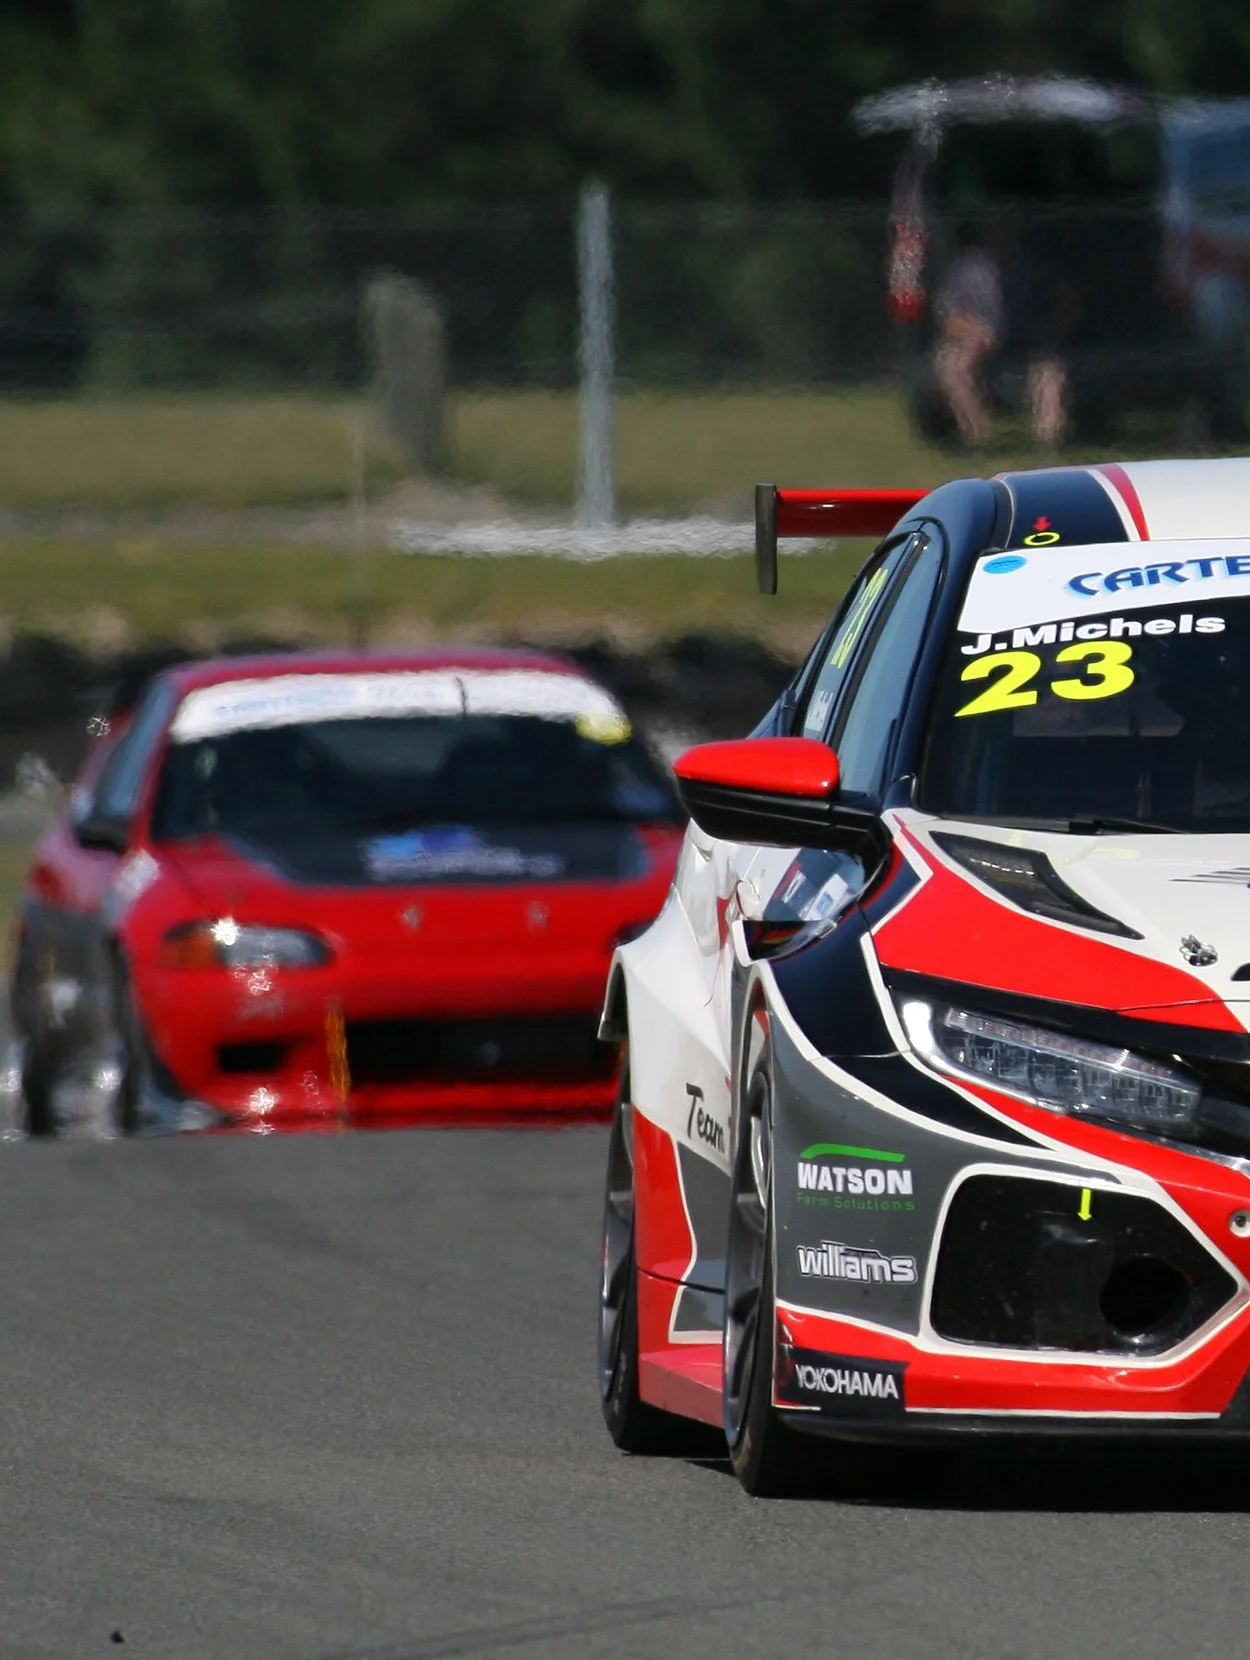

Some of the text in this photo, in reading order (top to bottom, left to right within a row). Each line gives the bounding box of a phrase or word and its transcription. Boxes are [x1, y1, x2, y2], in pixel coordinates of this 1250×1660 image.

[960, 613, 1226, 656] J.Michels
[954, 641, 1135, 718] 23
[685, 1081, 726, 1155] Team
[797, 1161, 914, 1195] WATSON
[796, 1192, 916, 1212] Farm Solutions
[798, 1240, 917, 1284] williams
[795, 1363, 900, 1400] YOKOHAMA
